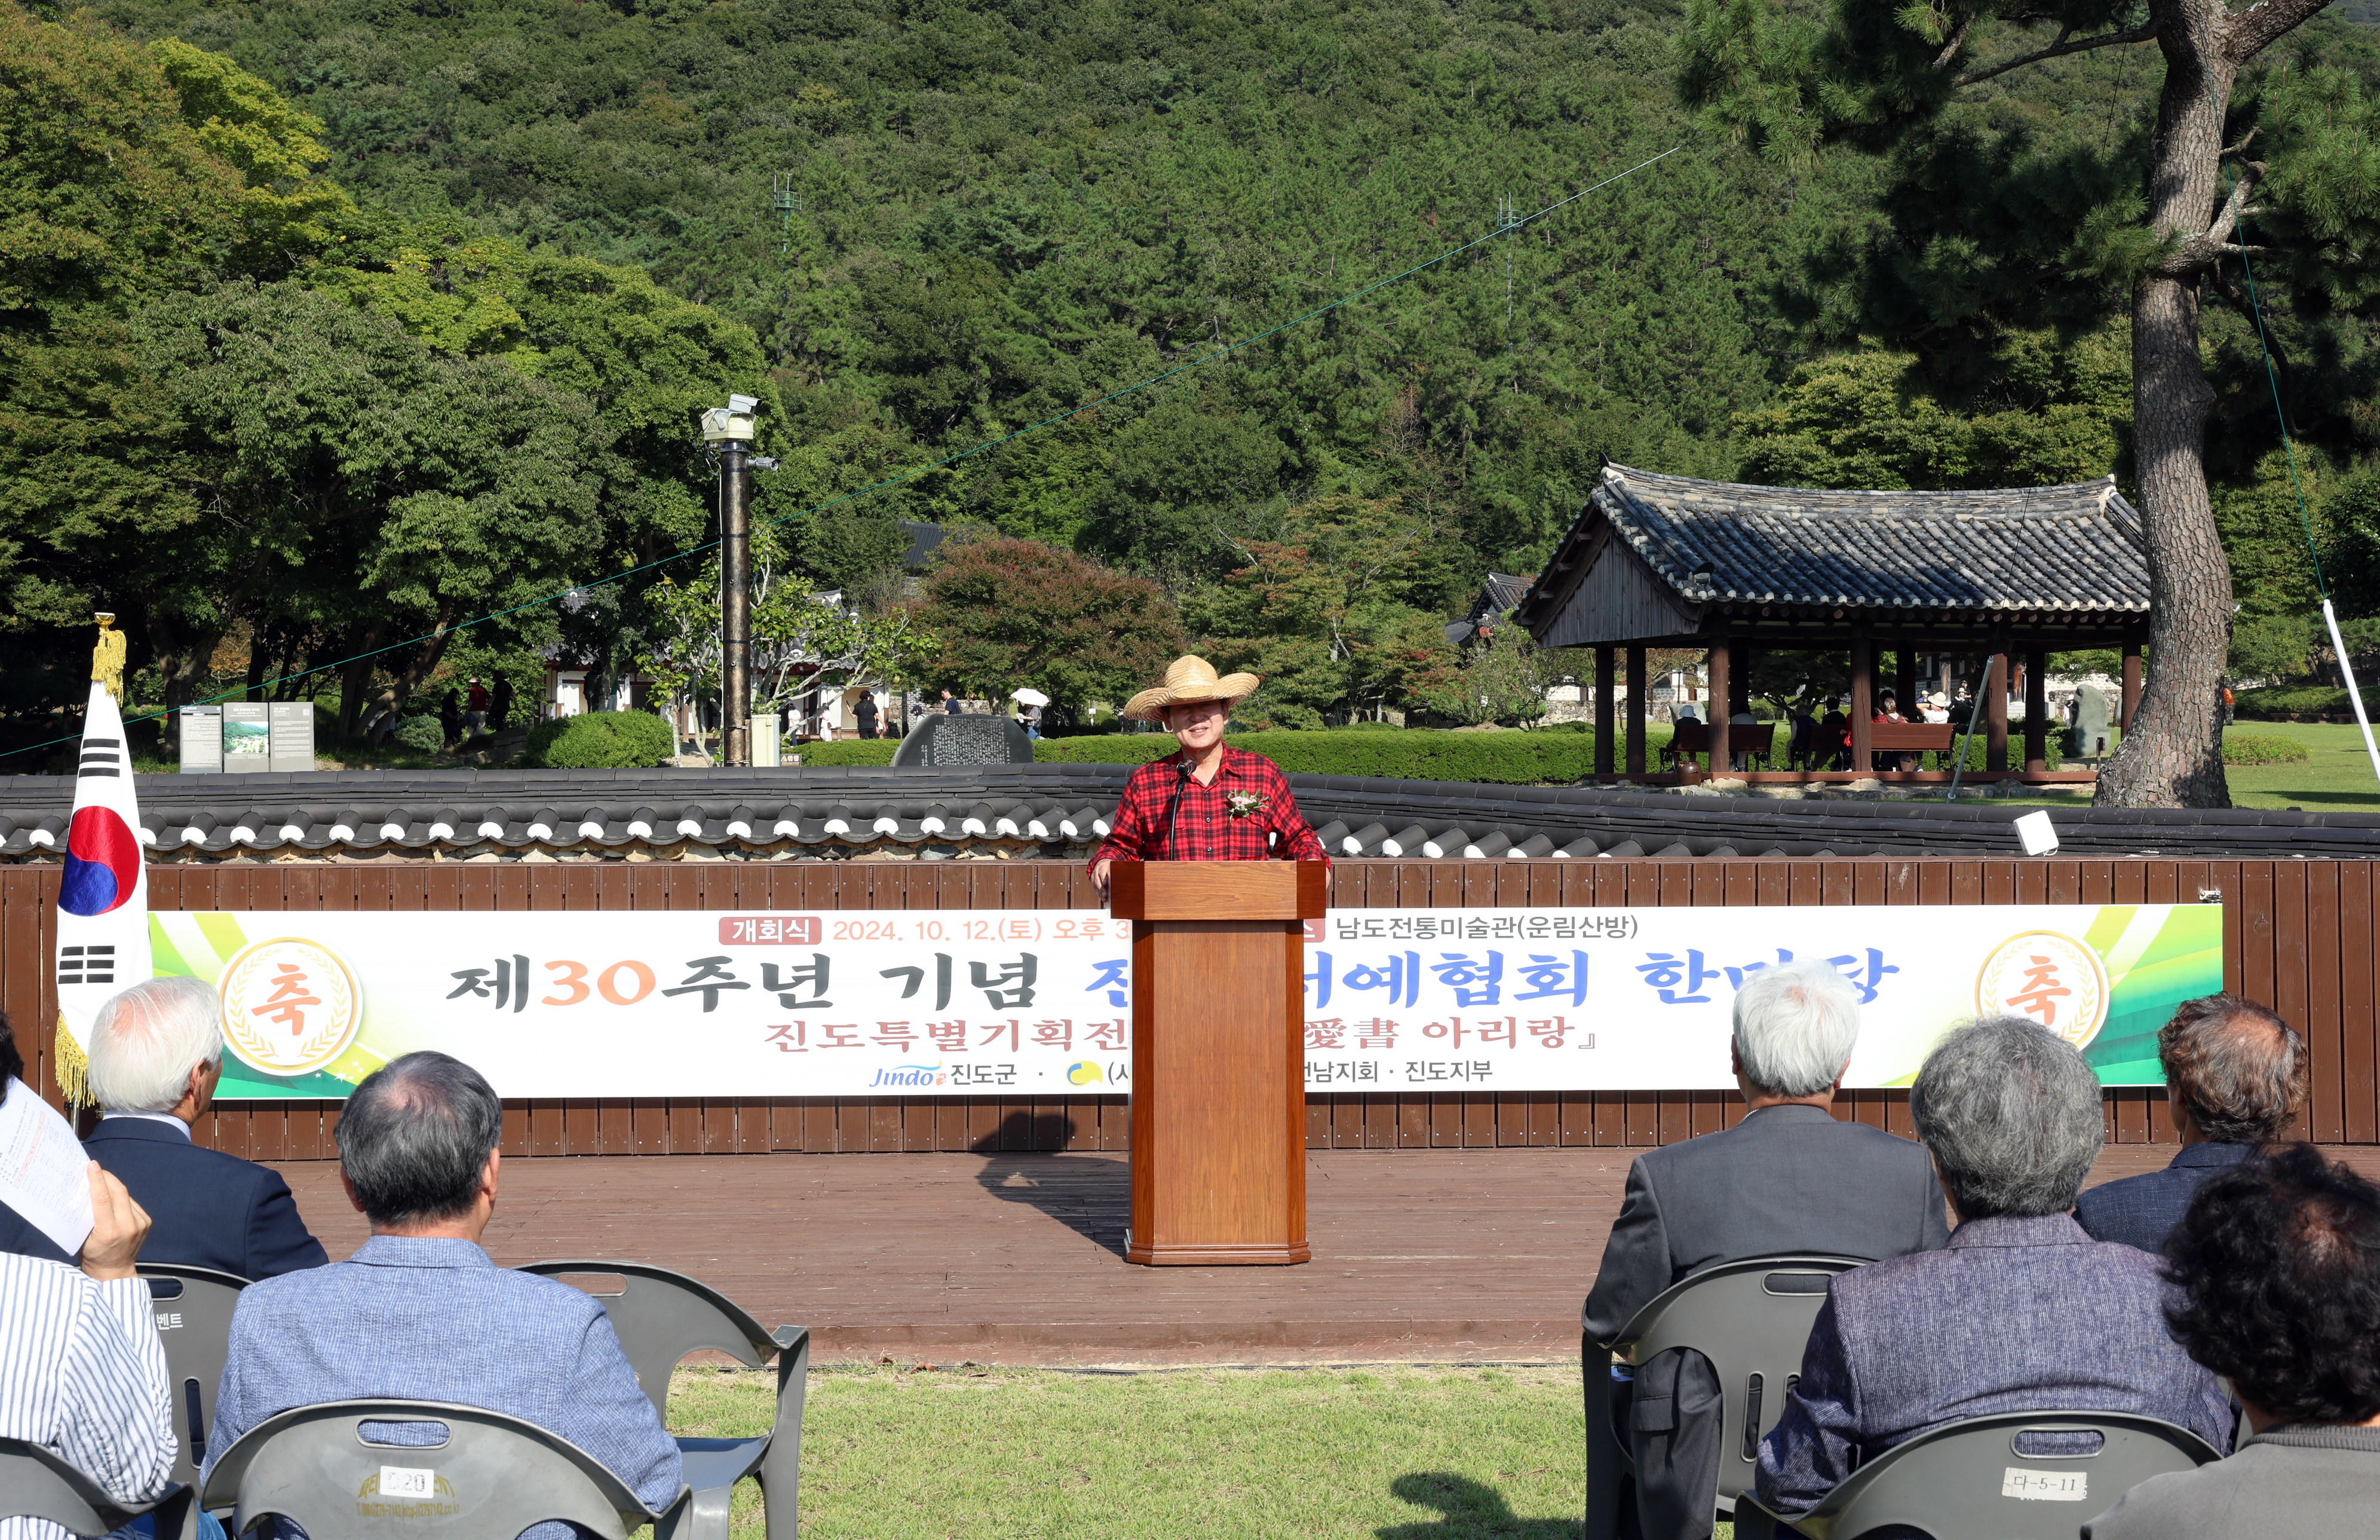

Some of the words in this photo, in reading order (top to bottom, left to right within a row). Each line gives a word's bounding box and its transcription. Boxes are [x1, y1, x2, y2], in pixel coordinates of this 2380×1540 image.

[731, 919, 809, 943] 개회식
[833, 921, 903, 941] 2024.
[915, 921, 950, 941] 10.
[962, 918, 1042, 943] 12.(토)
[1053, 918, 1105, 941] 오후
[1336, 915, 1638, 940] 남도전통미술관(운림산방)
[445, 952, 834, 1014] 제30주년
[878, 952, 1038, 1012] 기념
[2005, 955, 2072, 1026] 축
[251, 963, 322, 1036] 축
[763, 1018, 1128, 1053] 진도특별기획전
[869, 1068, 934, 1088] Jindo
[950, 1063, 1017, 1085] 진도군
[1305, 1060, 1378, 1083] 남지회
[1404, 1060, 1493, 1082] 진도지부
[153, 1312, 183, 1330] 벤트
[2013, 1475, 2075, 1491] 다-5-11
